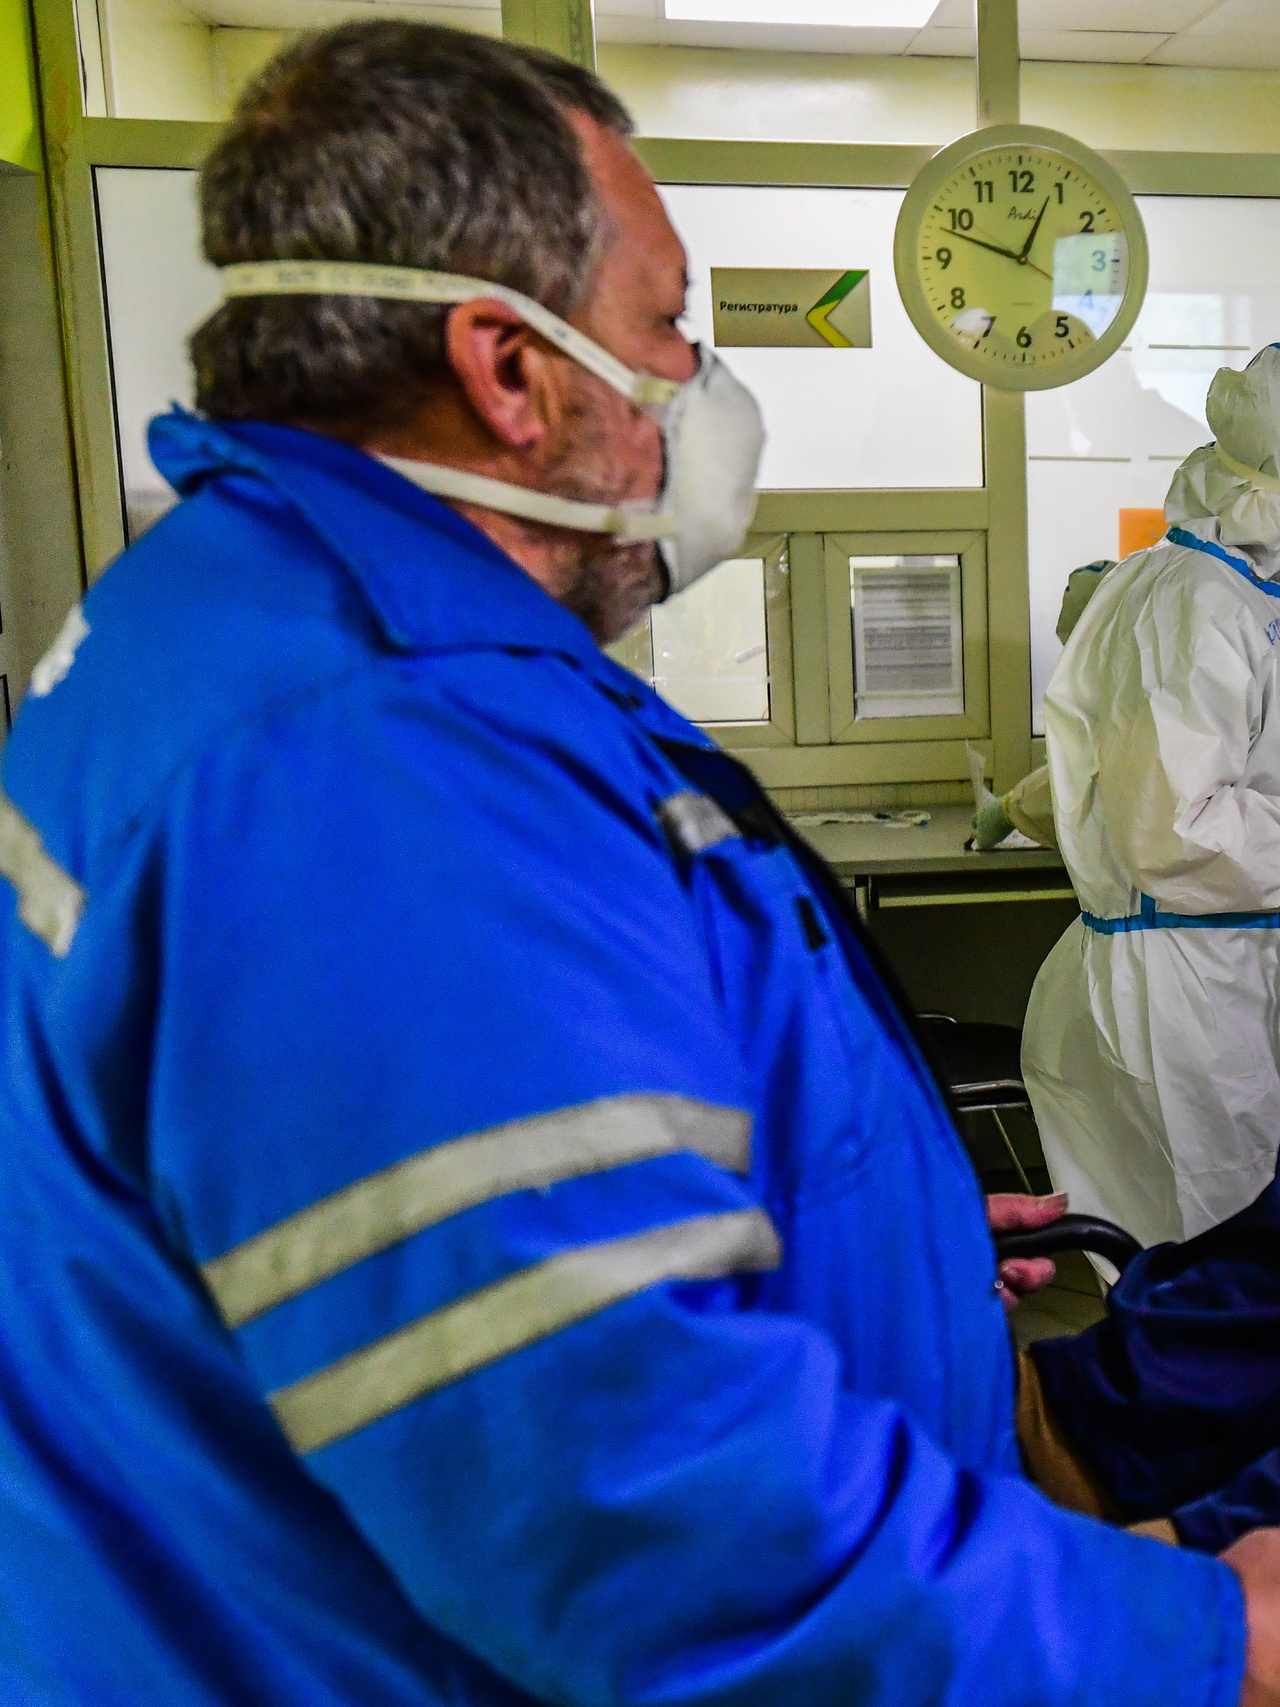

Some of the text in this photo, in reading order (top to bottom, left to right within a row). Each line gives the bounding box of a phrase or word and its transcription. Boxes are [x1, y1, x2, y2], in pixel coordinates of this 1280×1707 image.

[974, 181, 994, 203] 11
[1008, 170, 1035, 193] 12
[1054, 183, 1064, 204] 1
[950, 208, 974, 231] 10
[1080, 211, 1095, 233] 2
[936, 247, 952, 270] 9
[1091, 250, 1107, 272] 3
[720, 301, 798, 314] Регистратура
[950, 287, 966, 310] 8
[1078, 289, 1095, 311] 4
[981, 316, 997, 338] 7
[1016, 326, 1032, 348] 6
[1055, 316, 1070, 338] 5
